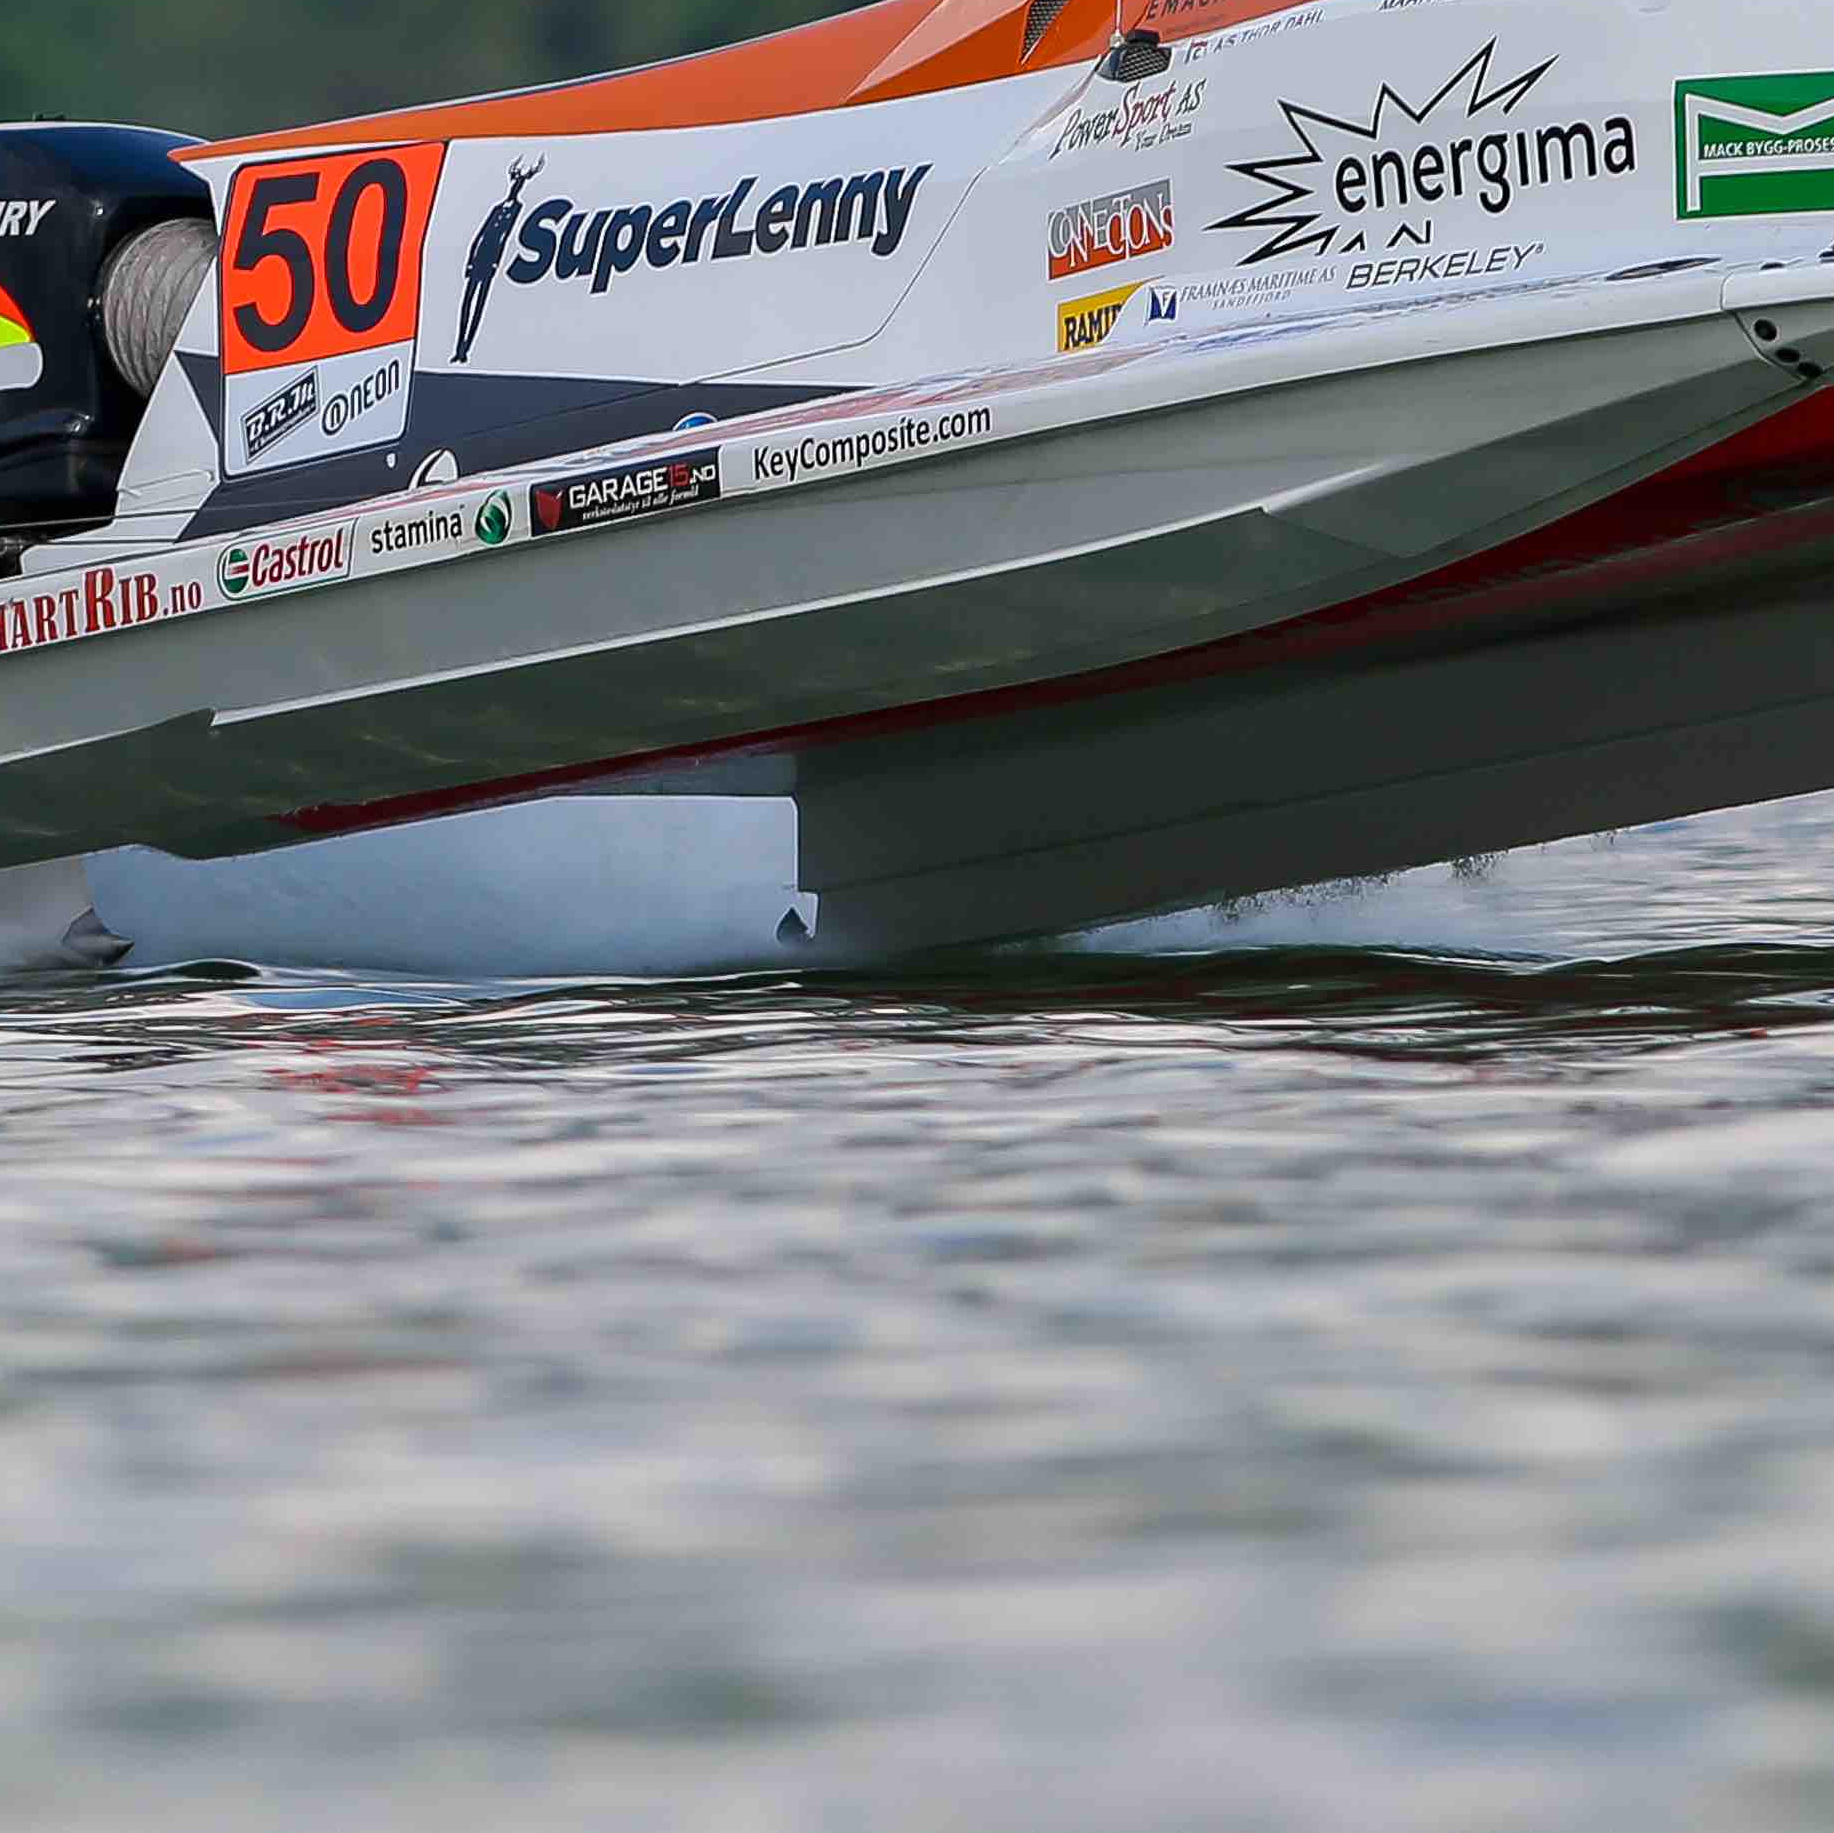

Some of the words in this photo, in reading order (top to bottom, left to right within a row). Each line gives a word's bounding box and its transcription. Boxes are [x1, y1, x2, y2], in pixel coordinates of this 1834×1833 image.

[1176, 78, 1207, 116] AS
[1335, 116, 1637, 214] energima
[1703, 142, 1743, 159] MACK
[233, 158, 408, 352] 50
[505, 162, 934, 295] SuperLenny
[1247, 269, 1317, 292] MARITIME
[1317, 265, 1337, 282] AS
[753, 407, 992, 482] KeyComposite.com
[251, 527, 344, 587] Castrol
[371, 510, 463, 554] stamina
